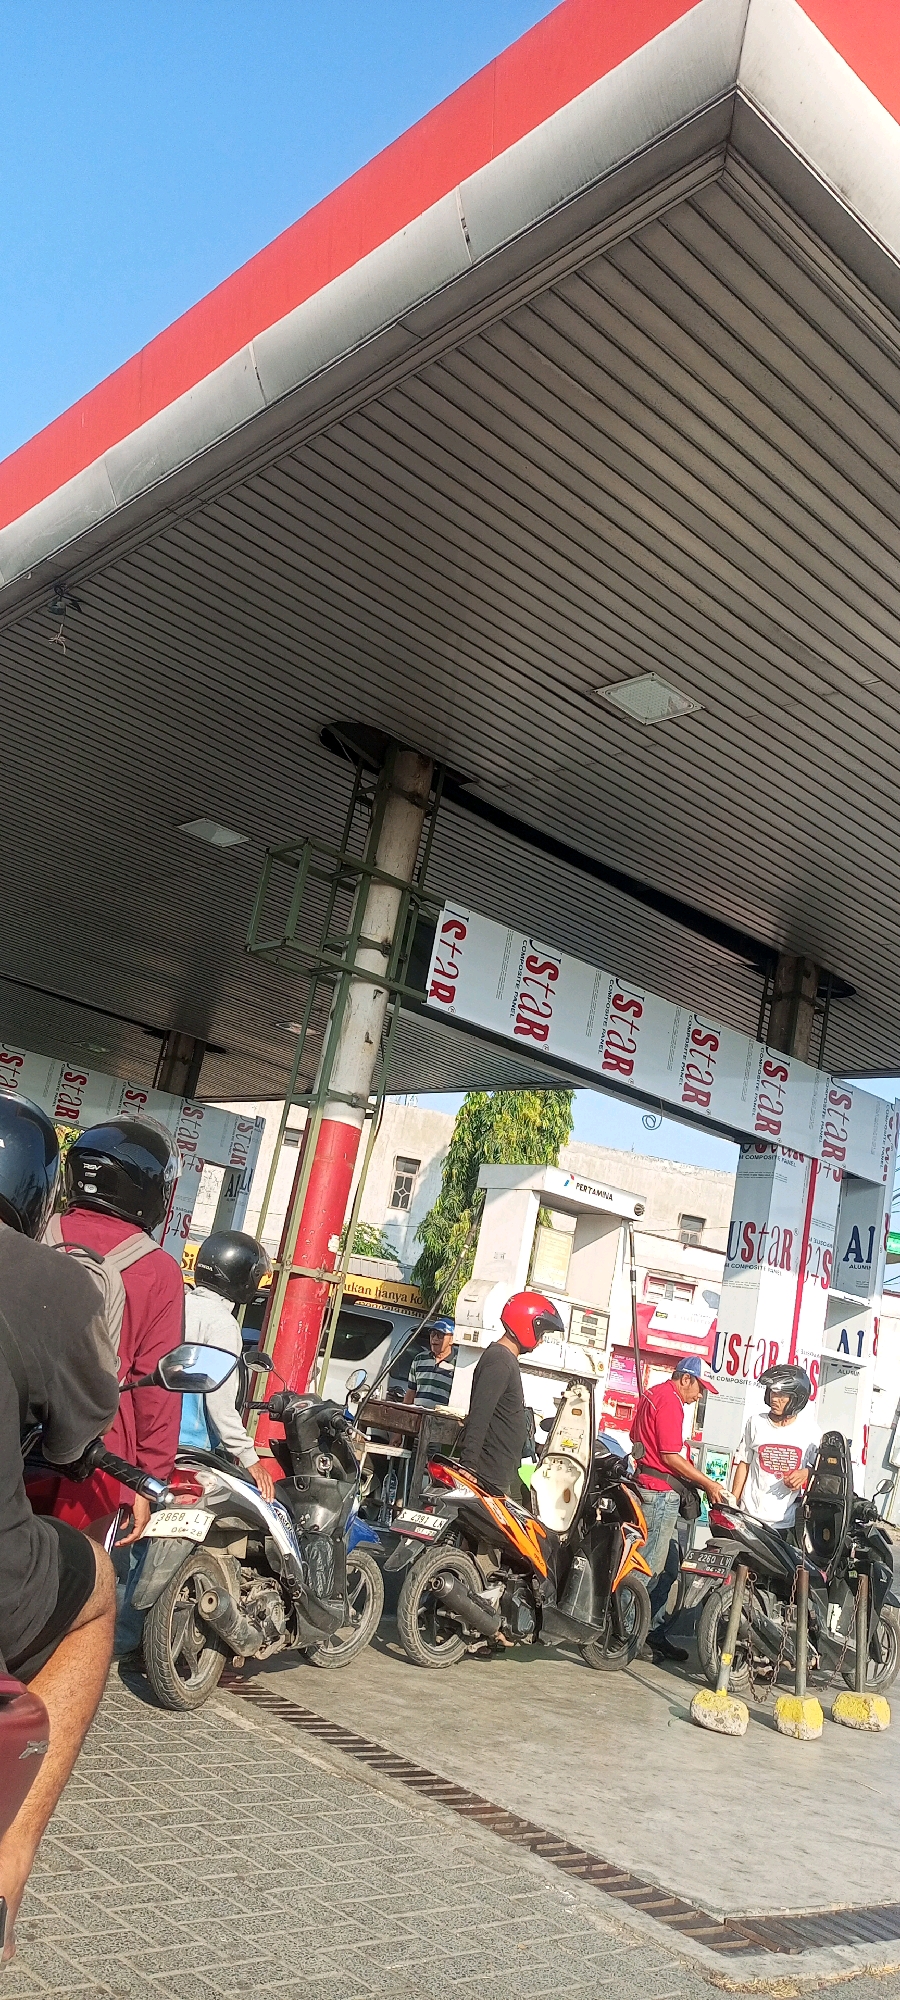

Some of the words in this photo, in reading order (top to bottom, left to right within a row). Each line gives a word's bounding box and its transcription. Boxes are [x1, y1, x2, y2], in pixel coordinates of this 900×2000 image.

[515, 939, 528, 990] COMPOSITE
[509, 991, 519, 1019] PANEL
[602, 979, 615, 1028] COMPOSITE
[597, 1028, 606, 1055] PANEL
[682, 1014, 693, 1061] COMPOSITE
[745, 1154, 781, 1163] COMPOSITE
[576, 1182, 614, 1202] PERTAMINA
[730, 1263, 767, 1272] COMPOSITE
[344, 1281, 372, 1296] ukan
[375, 1286, 408, 1304] hanya
[716, 1375, 752, 1386] COMPOSITE
[194, 1513, 211, 1526] LT
[688, 1552, 695, 1560] S
[697, 1553, 717, 1564] 2260
